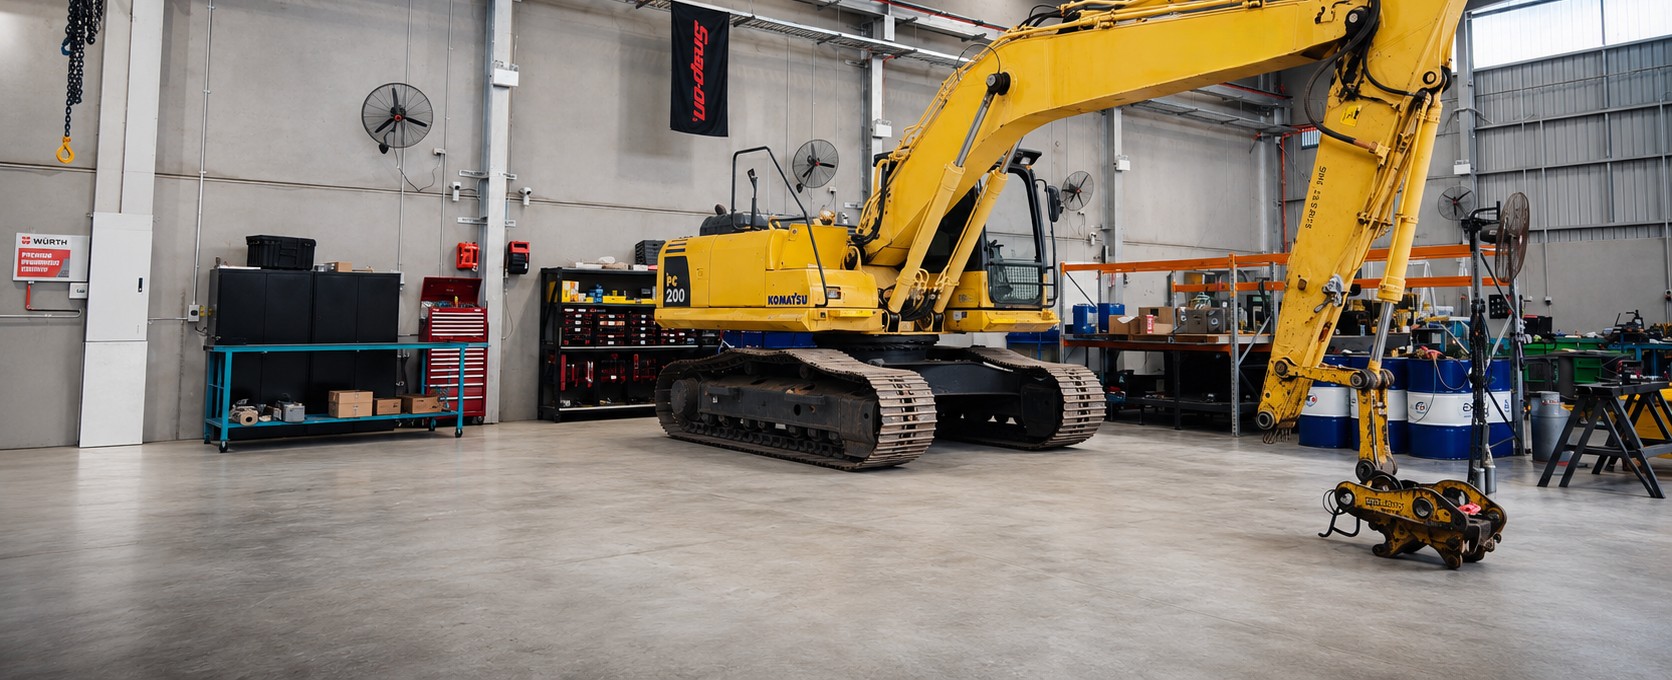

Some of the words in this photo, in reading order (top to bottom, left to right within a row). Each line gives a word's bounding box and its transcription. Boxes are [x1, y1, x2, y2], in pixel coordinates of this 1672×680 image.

[33, 237, 68, 246] WÜRTH
[666, 274, 678, 287] PC
[666, 288, 685, 303] 200
[767, 293, 808, 305] KOMATSU
